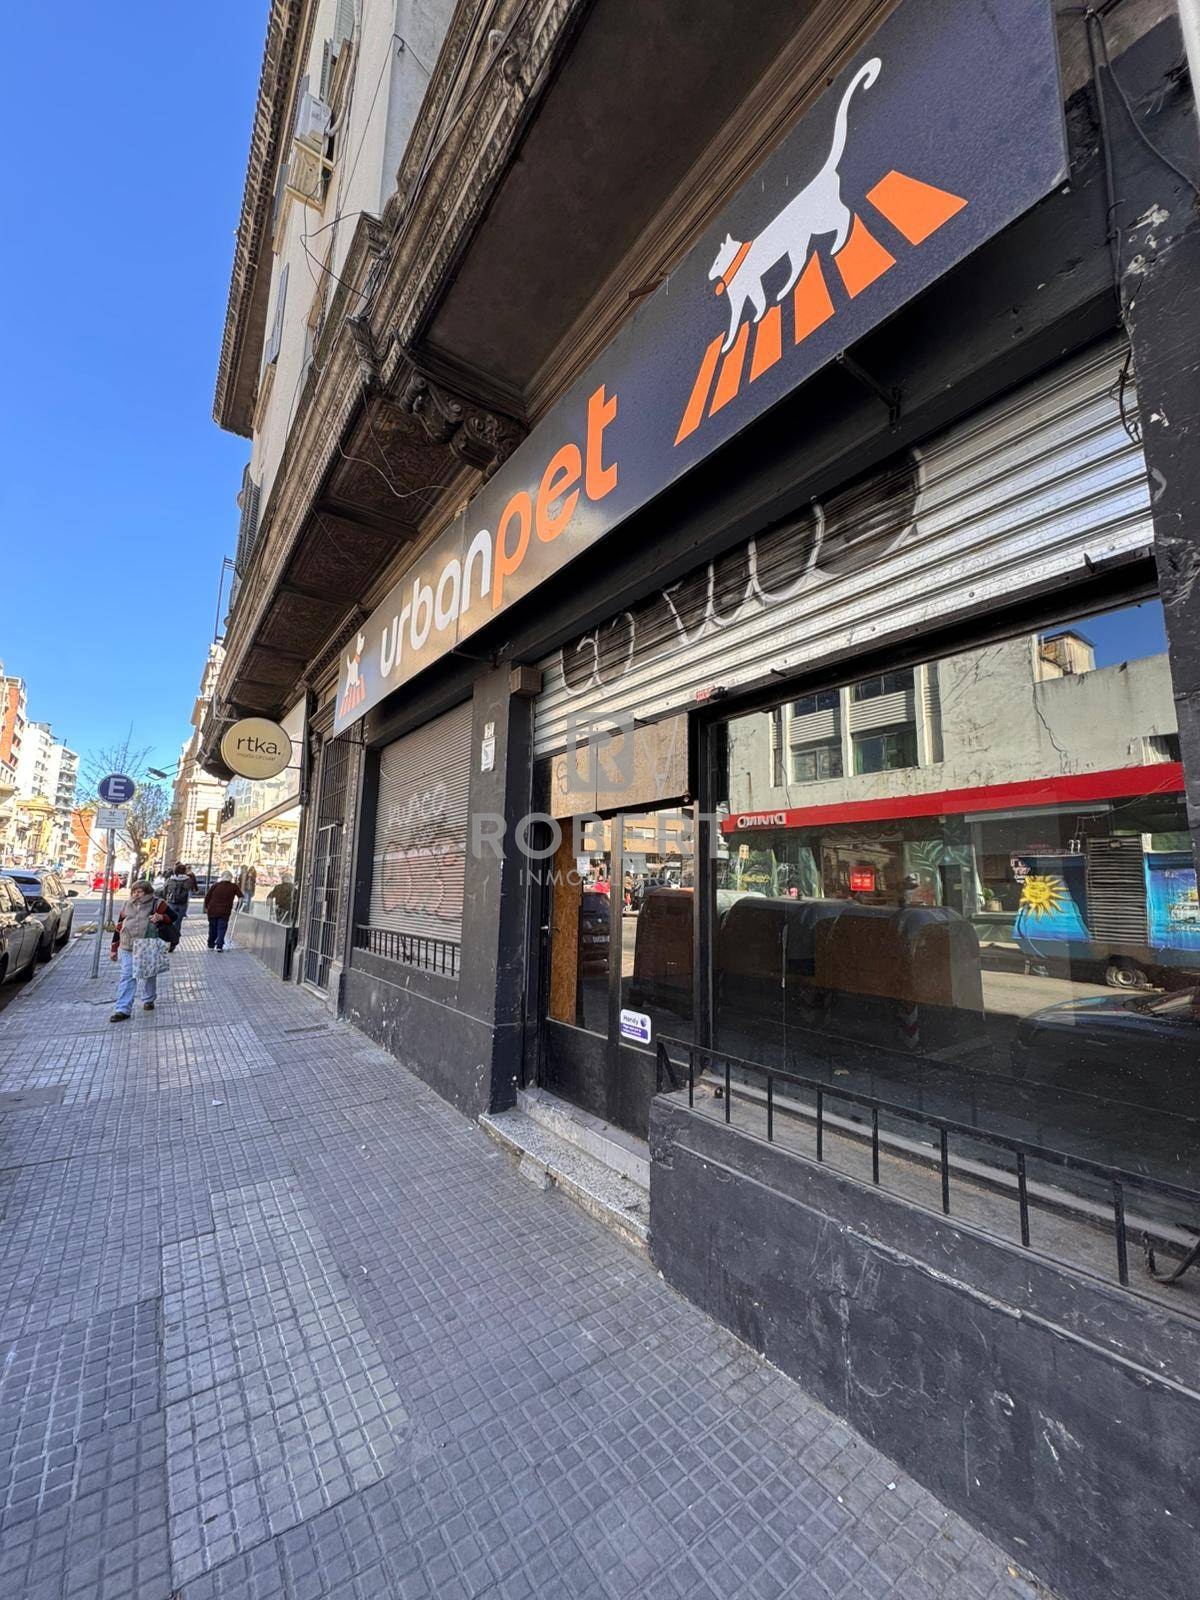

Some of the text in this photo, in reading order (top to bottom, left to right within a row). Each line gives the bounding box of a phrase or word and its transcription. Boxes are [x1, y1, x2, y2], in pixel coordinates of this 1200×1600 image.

[380, 384, 618, 678] urbanpet
[237, 736, 281, 755] rtka.
[108, 777, 127, 797] E
